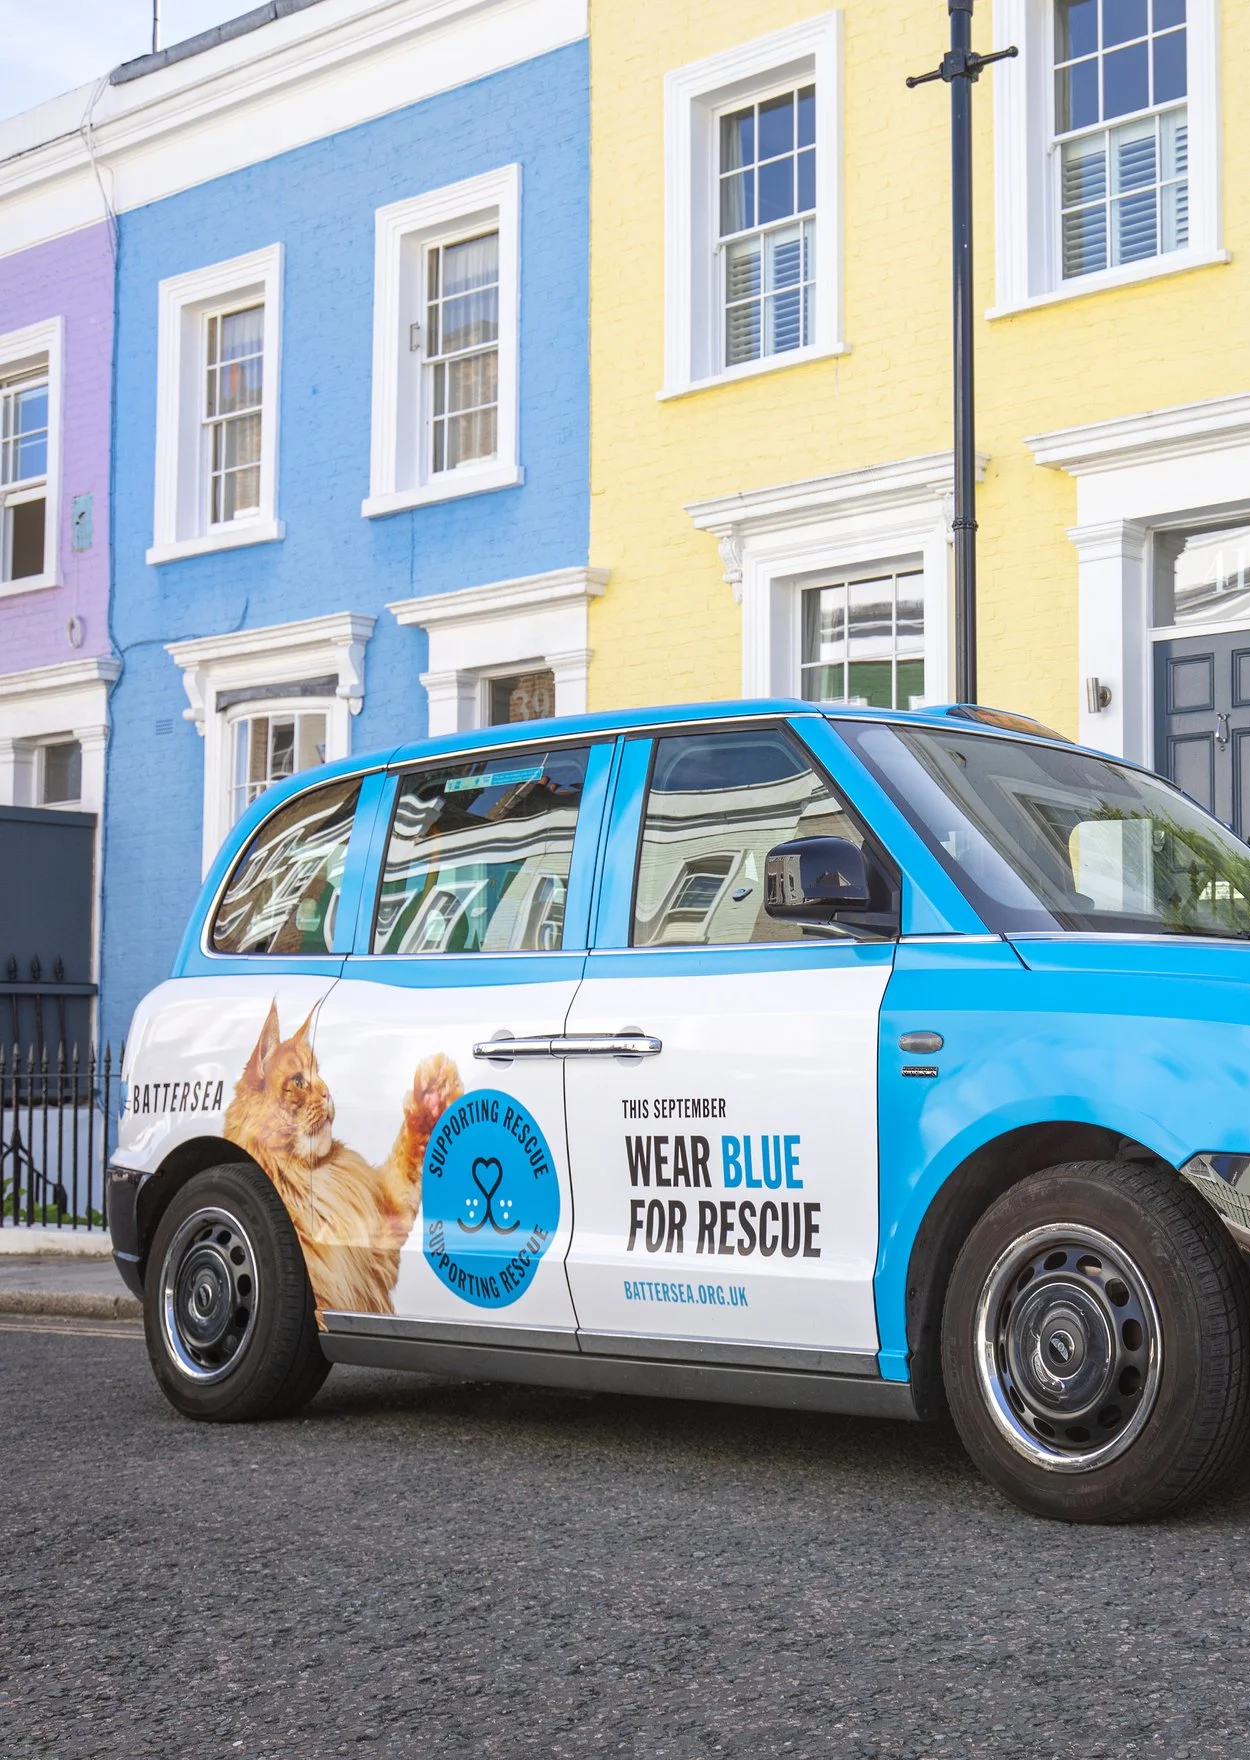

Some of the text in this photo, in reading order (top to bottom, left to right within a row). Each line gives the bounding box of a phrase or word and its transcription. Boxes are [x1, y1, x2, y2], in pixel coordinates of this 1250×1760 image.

[510, 688, 551, 720] 39
[133, 1080, 224, 1114] BATTERSEA
[622, 1098, 726, 1119] THIS SEPTEMBER
[428, 1098, 549, 1180] SUPPORTING RESCUE
[624, 1134, 804, 1190] WEAR BLUE
[626, 1198, 821, 1258] FOR RESCUE
[428, 1219, 549, 1300] SUPPORTING RESCUE
[623, 1280, 749, 1307] BATTERSEA.ORG.UK
